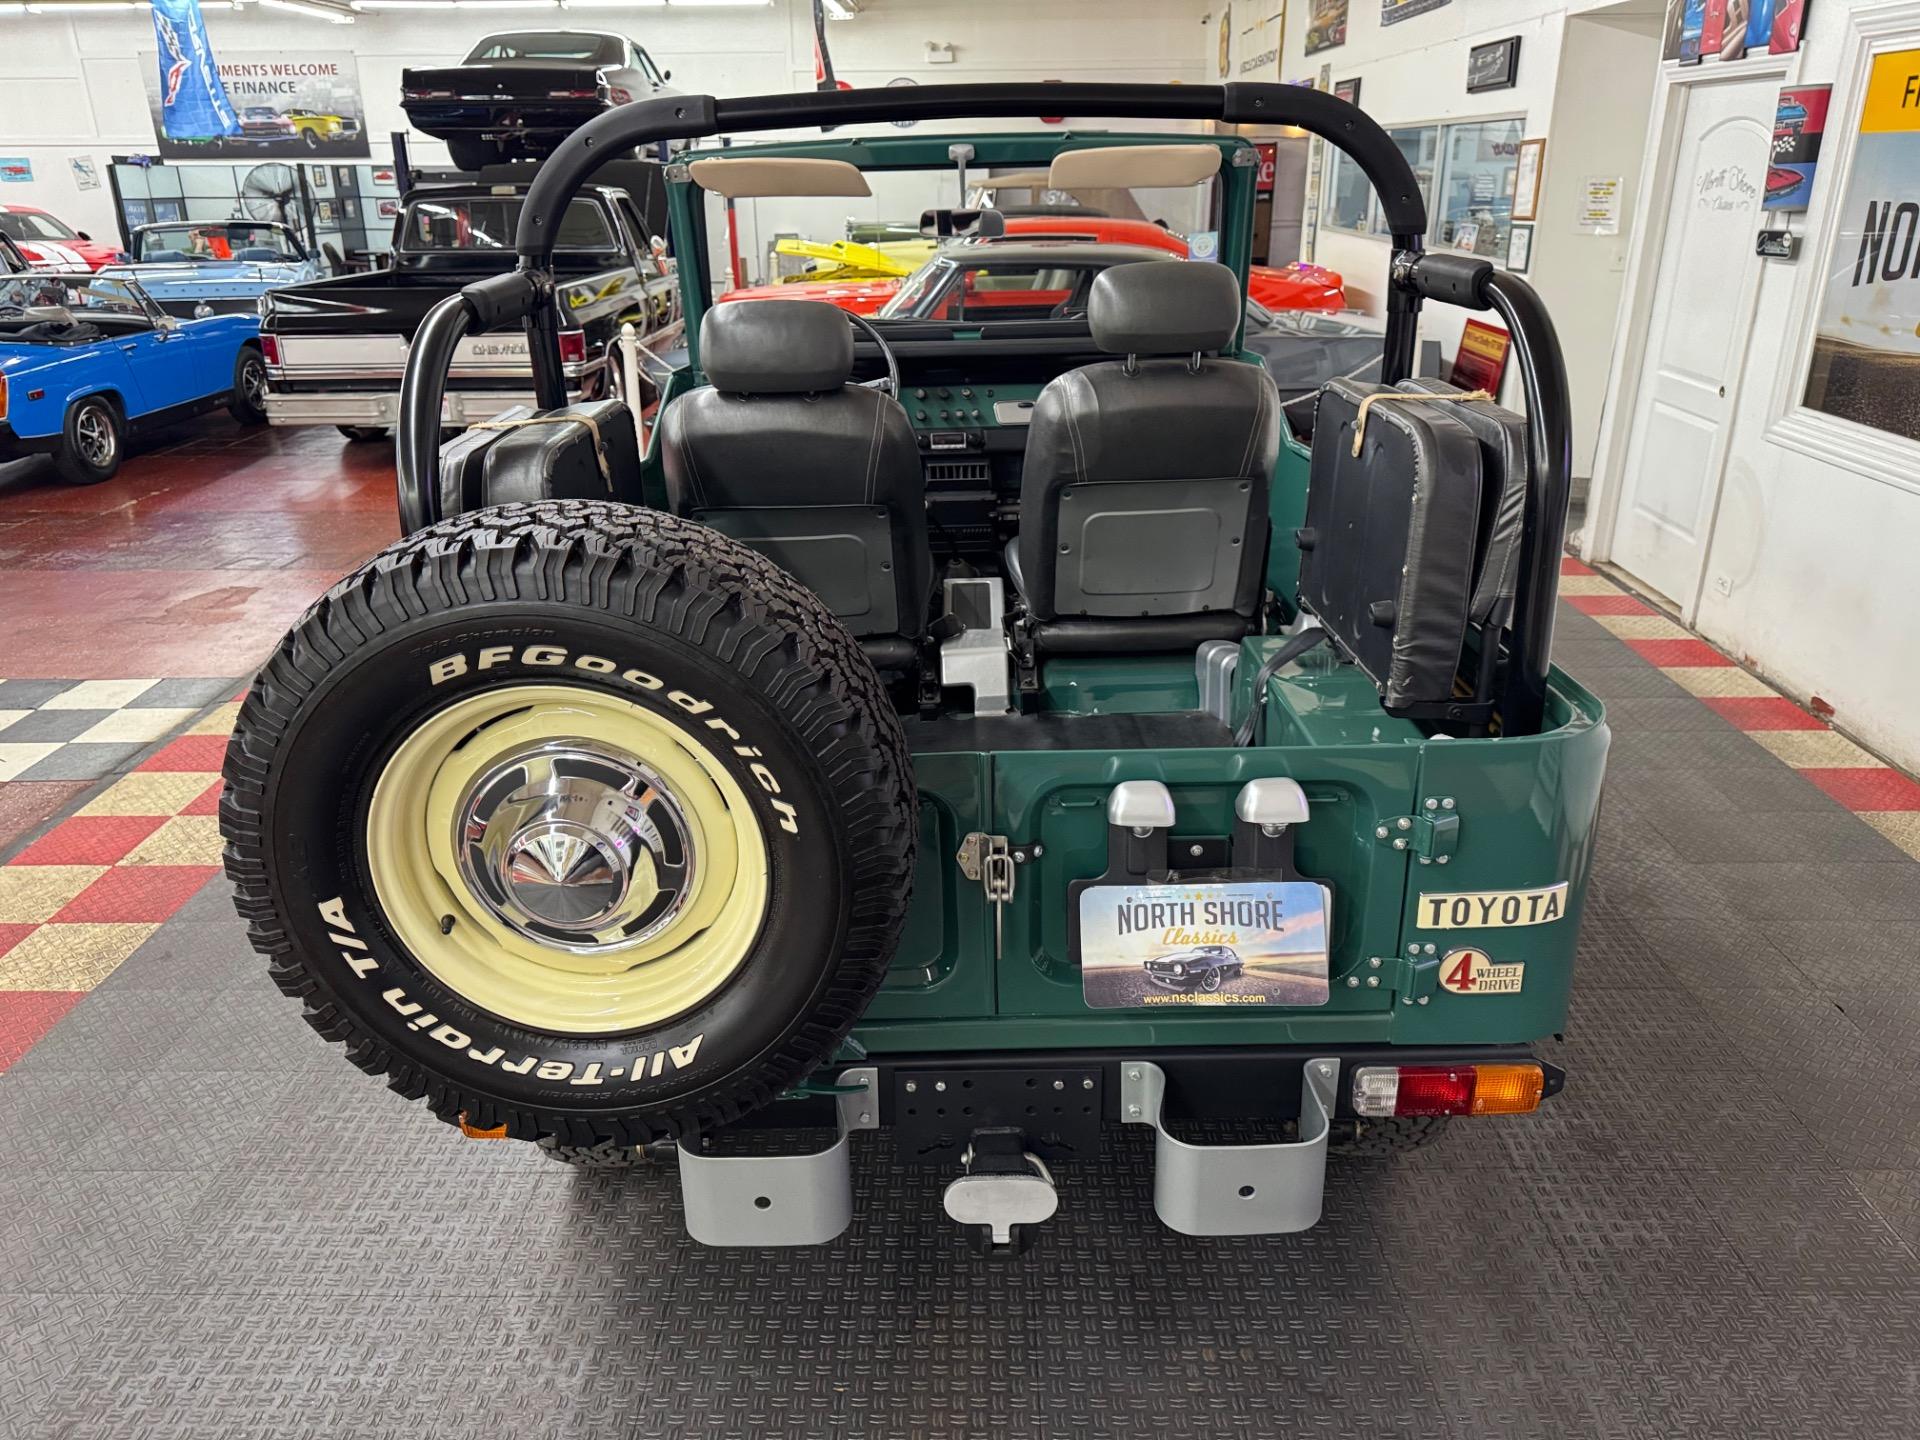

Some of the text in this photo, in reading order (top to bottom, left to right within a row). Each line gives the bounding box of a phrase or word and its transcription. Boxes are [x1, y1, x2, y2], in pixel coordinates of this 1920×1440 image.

[270, 64, 338, 76] WELCOME
[233, 81, 296, 94] FINANCE
[472, 344, 529, 355] CHEVROL
[429, 644, 799, 834] BFGoodrich
[1118, 900, 1285, 936] NORTH SHORE
[1429, 892, 1559, 927] TOYOTA
[318, 896, 380, 980] T/A
[1162, 927, 1240, 946] Classics
[1445, 953, 1521, 991] 4 WHEEL
[1478, 979, 1520, 991] DRIVE
[1143, 992, 1266, 1004] www.nsclassics.com
[382, 987, 704, 1086] All-Terrain
